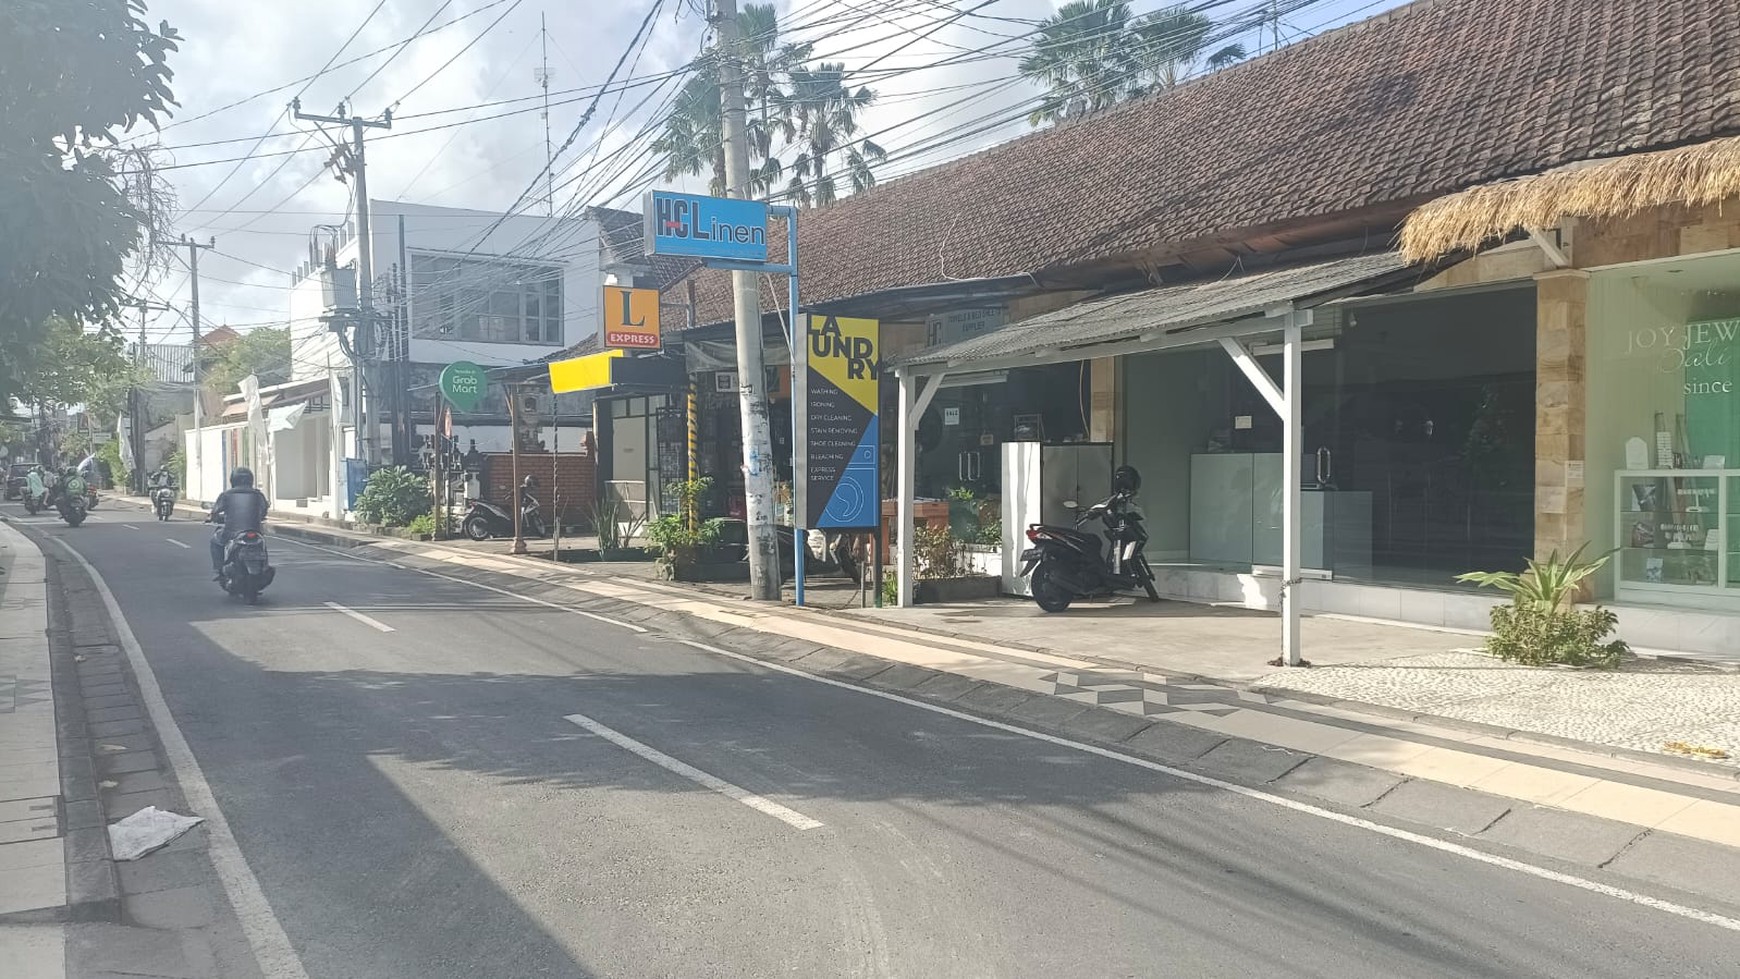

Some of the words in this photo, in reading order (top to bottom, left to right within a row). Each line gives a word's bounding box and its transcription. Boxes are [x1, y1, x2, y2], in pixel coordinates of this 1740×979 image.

[619, 290, 646, 327] L
[609, 333, 655, 344] EXPRESS
[1625, 327, 1675, 354] JOY
[452, 375, 478, 385] Grab
[1683, 377, 1733, 395] since
[452, 385, 478, 394] Mart
